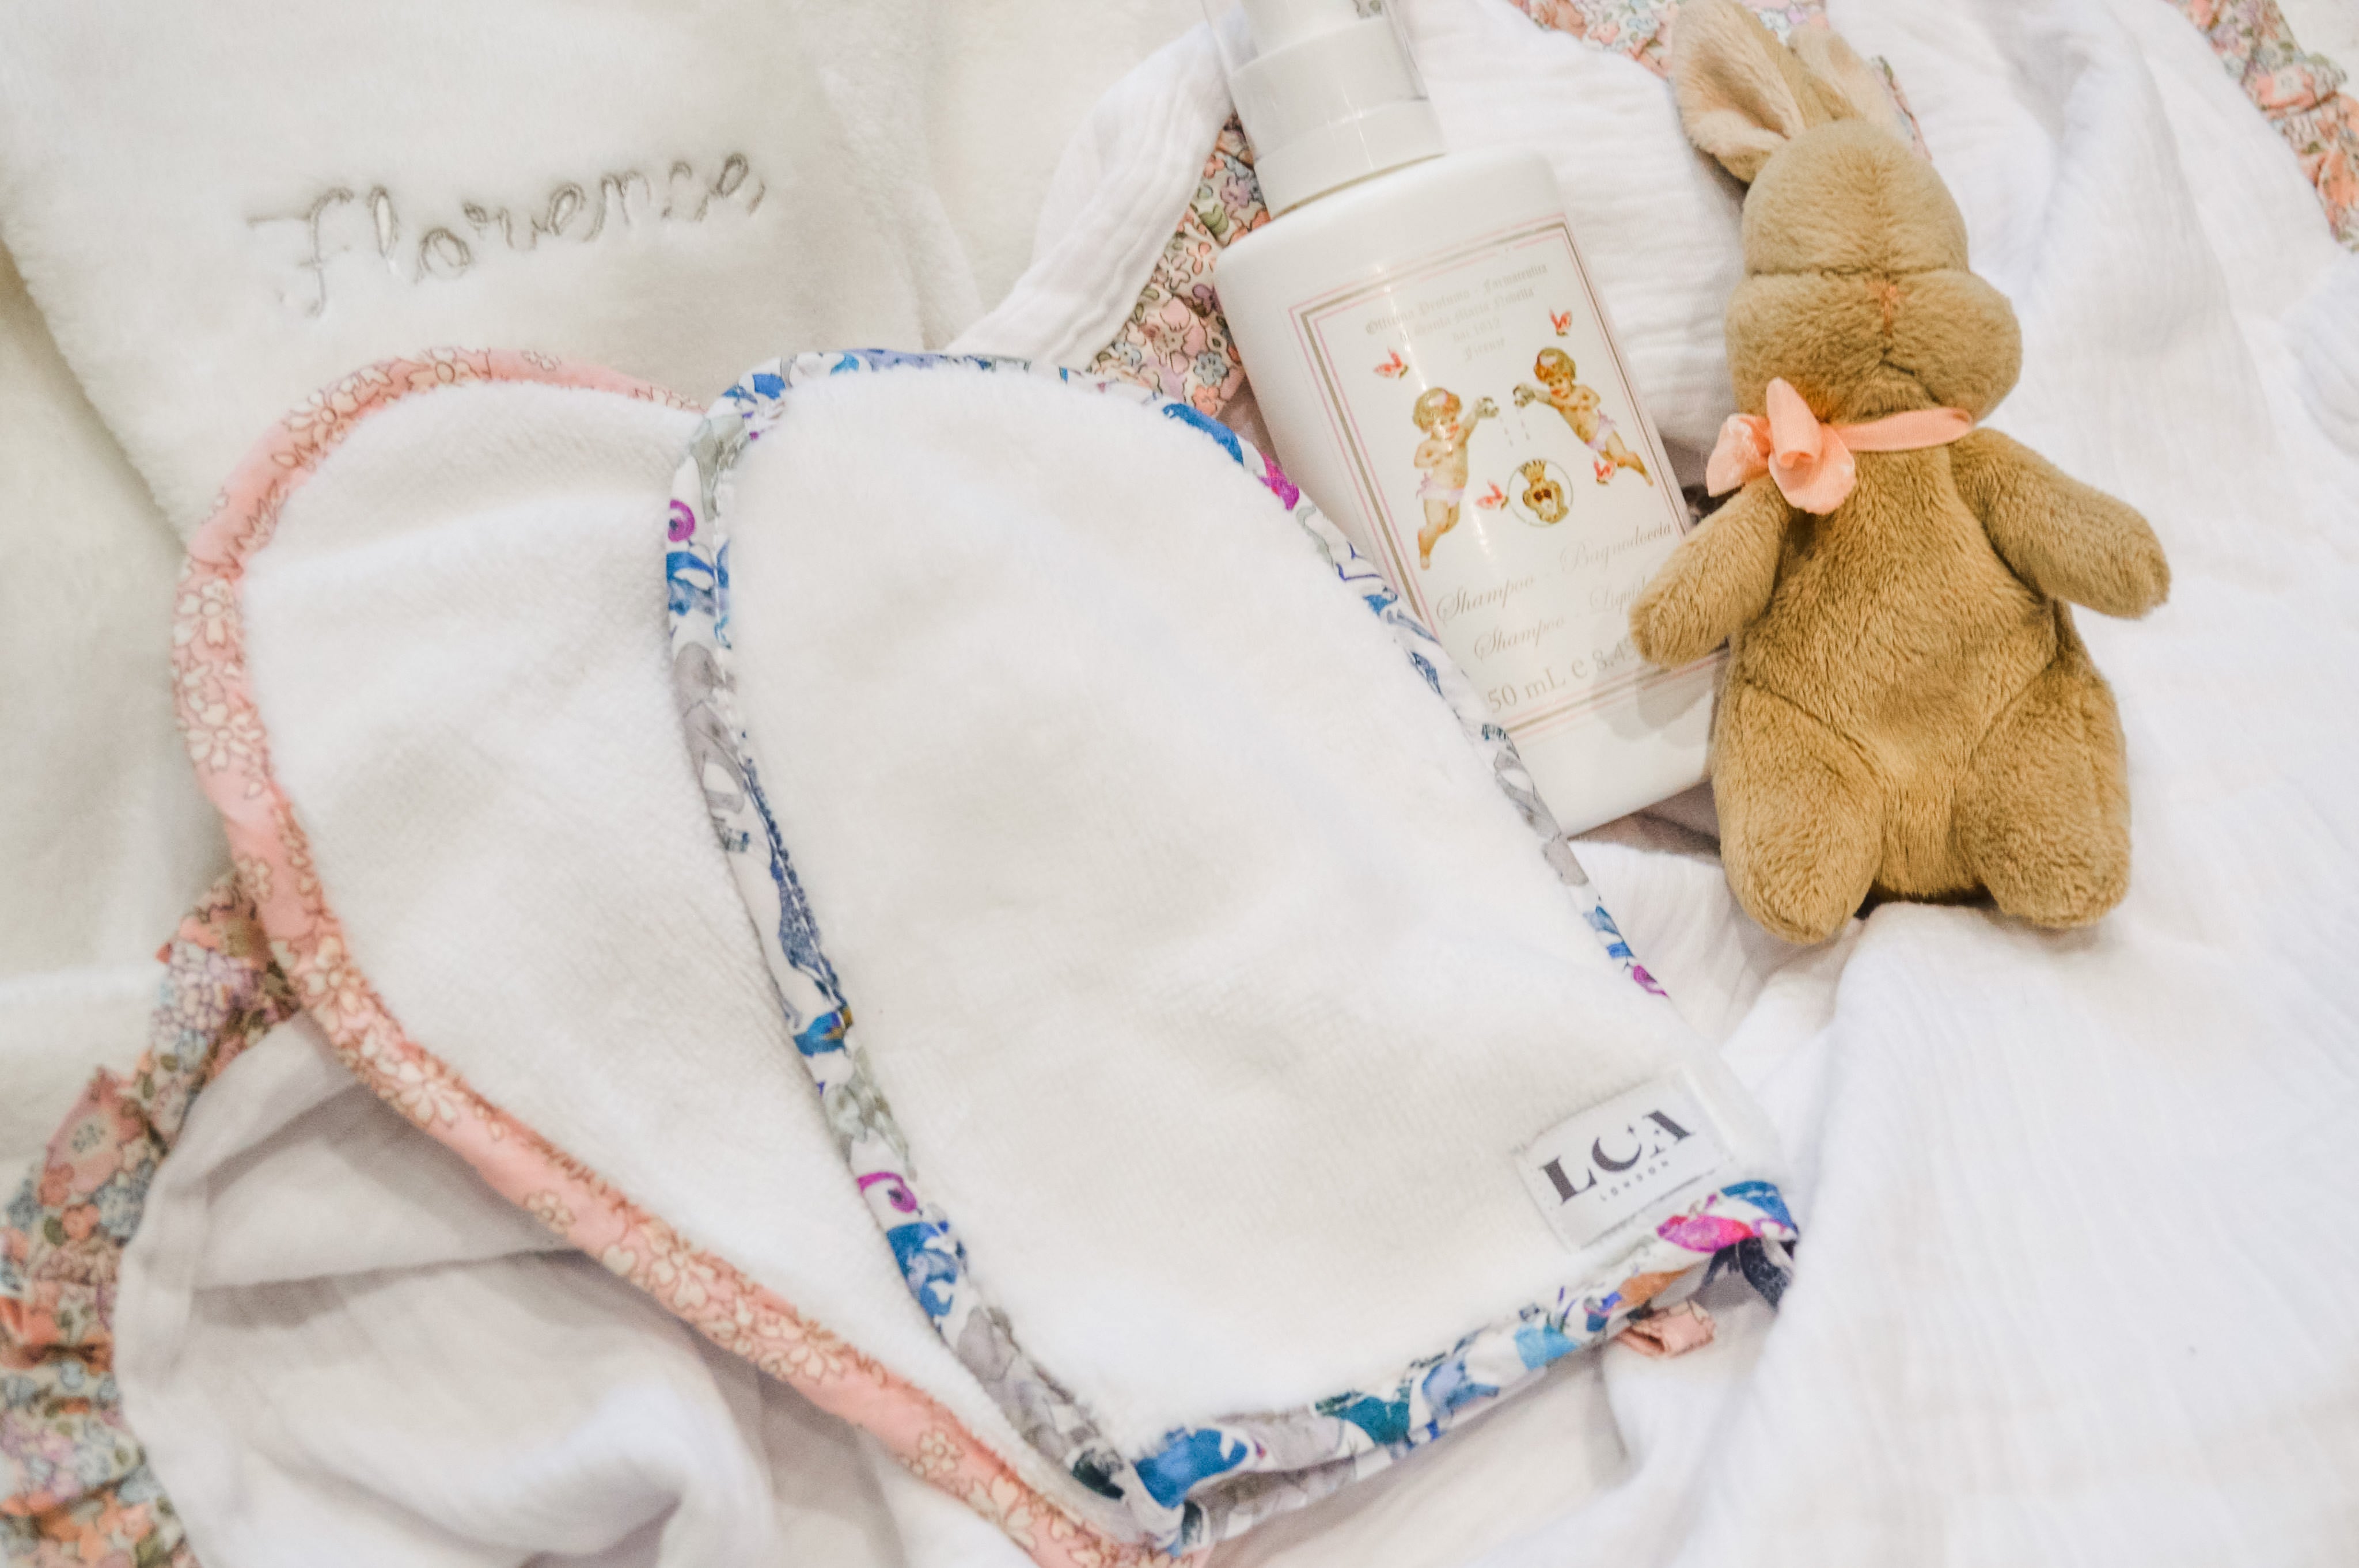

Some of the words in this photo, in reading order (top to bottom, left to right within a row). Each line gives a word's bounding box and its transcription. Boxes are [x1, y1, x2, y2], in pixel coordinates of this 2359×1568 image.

[1436, 576, 1537, 627] Shampoo
[1474, 616, 1567, 663] Shampoo
[1524, 666, 1567, 699] mL
[1538, 1110, 1697, 1206] LCA
